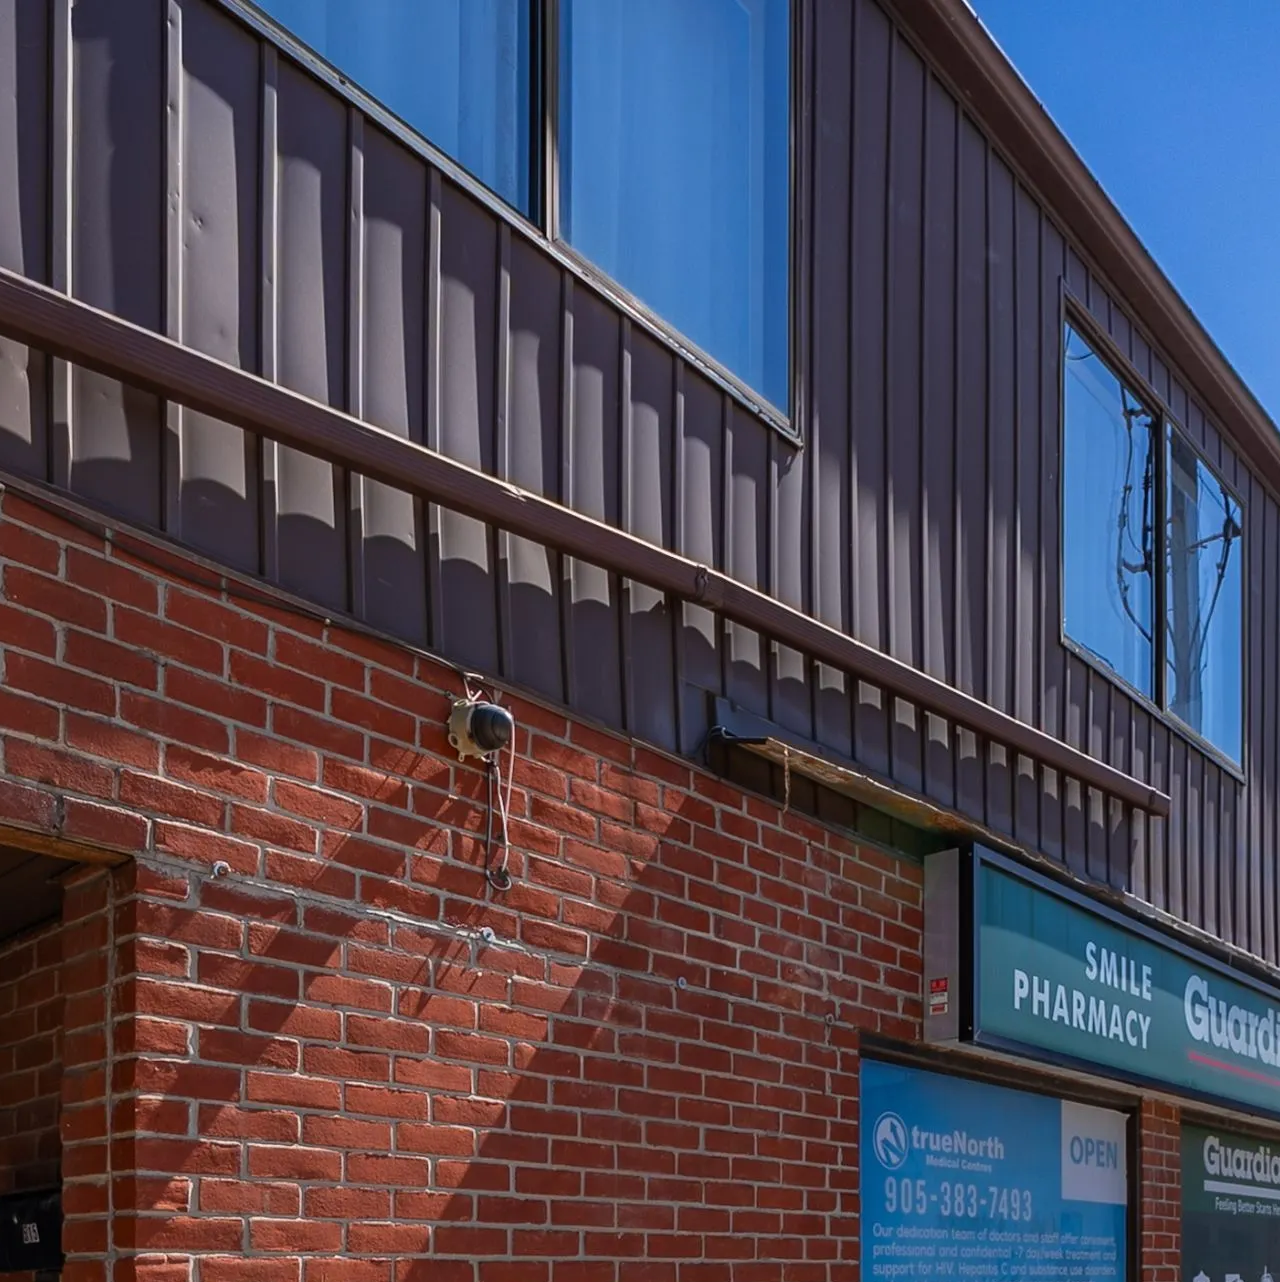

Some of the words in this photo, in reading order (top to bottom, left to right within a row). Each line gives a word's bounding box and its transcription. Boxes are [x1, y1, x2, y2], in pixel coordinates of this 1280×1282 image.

[1085, 940, 1153, 1001] SMILE
[1013, 968, 1152, 1050] PHARMACY
[912, 1125, 1005, 1160] trueNorth
[1070, 1135, 1118, 1170] OPEN
[925, 1155, 960, 1169] Medical
[884, 1175, 1032, 1222] 905-383-7493
[872, 1222, 894, 1238] Our
[872, 1241, 936, 1260] professional
[938, 1243, 958, 1257] and
[872, 1261, 914, 1279] support
[917, 1261, 933, 1275] for
[1000, 1261, 1009, 1276] C
